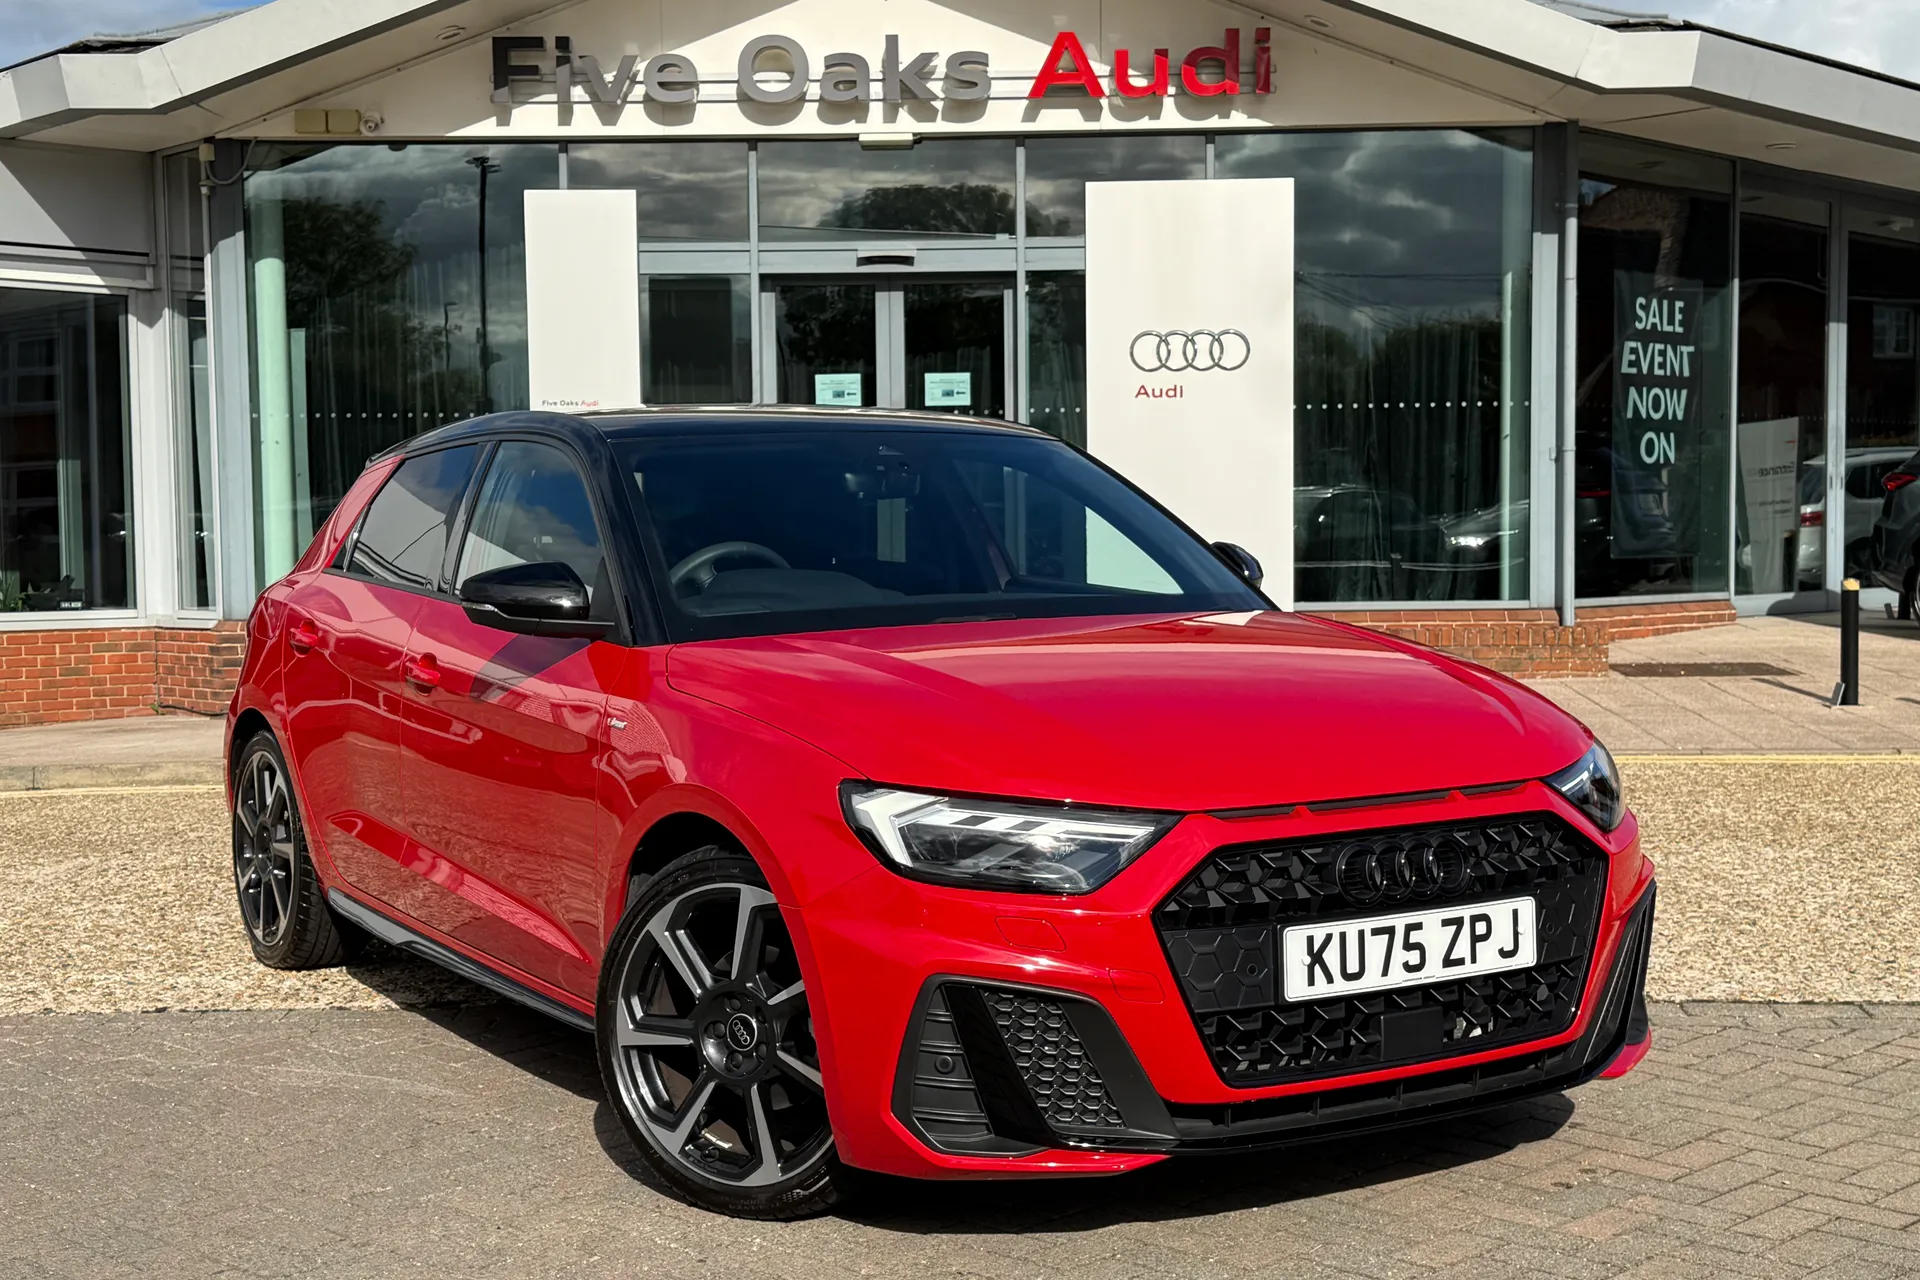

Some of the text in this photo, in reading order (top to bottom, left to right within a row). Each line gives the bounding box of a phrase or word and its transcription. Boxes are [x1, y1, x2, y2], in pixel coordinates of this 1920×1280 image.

[491, 27, 1272, 104] Five Oaks Audi
[1634, 296, 1685, 334] SALE
[1620, 341, 1696, 378] EVENT
[541, 399, 599, 407] Five Oaks Audi
[1134, 384, 1185, 400] Audi
[1626, 386, 1688, 421] NOW
[1639, 430, 1676, 465] ON
[1305, 908, 1520, 988] KU75 ZPJ
